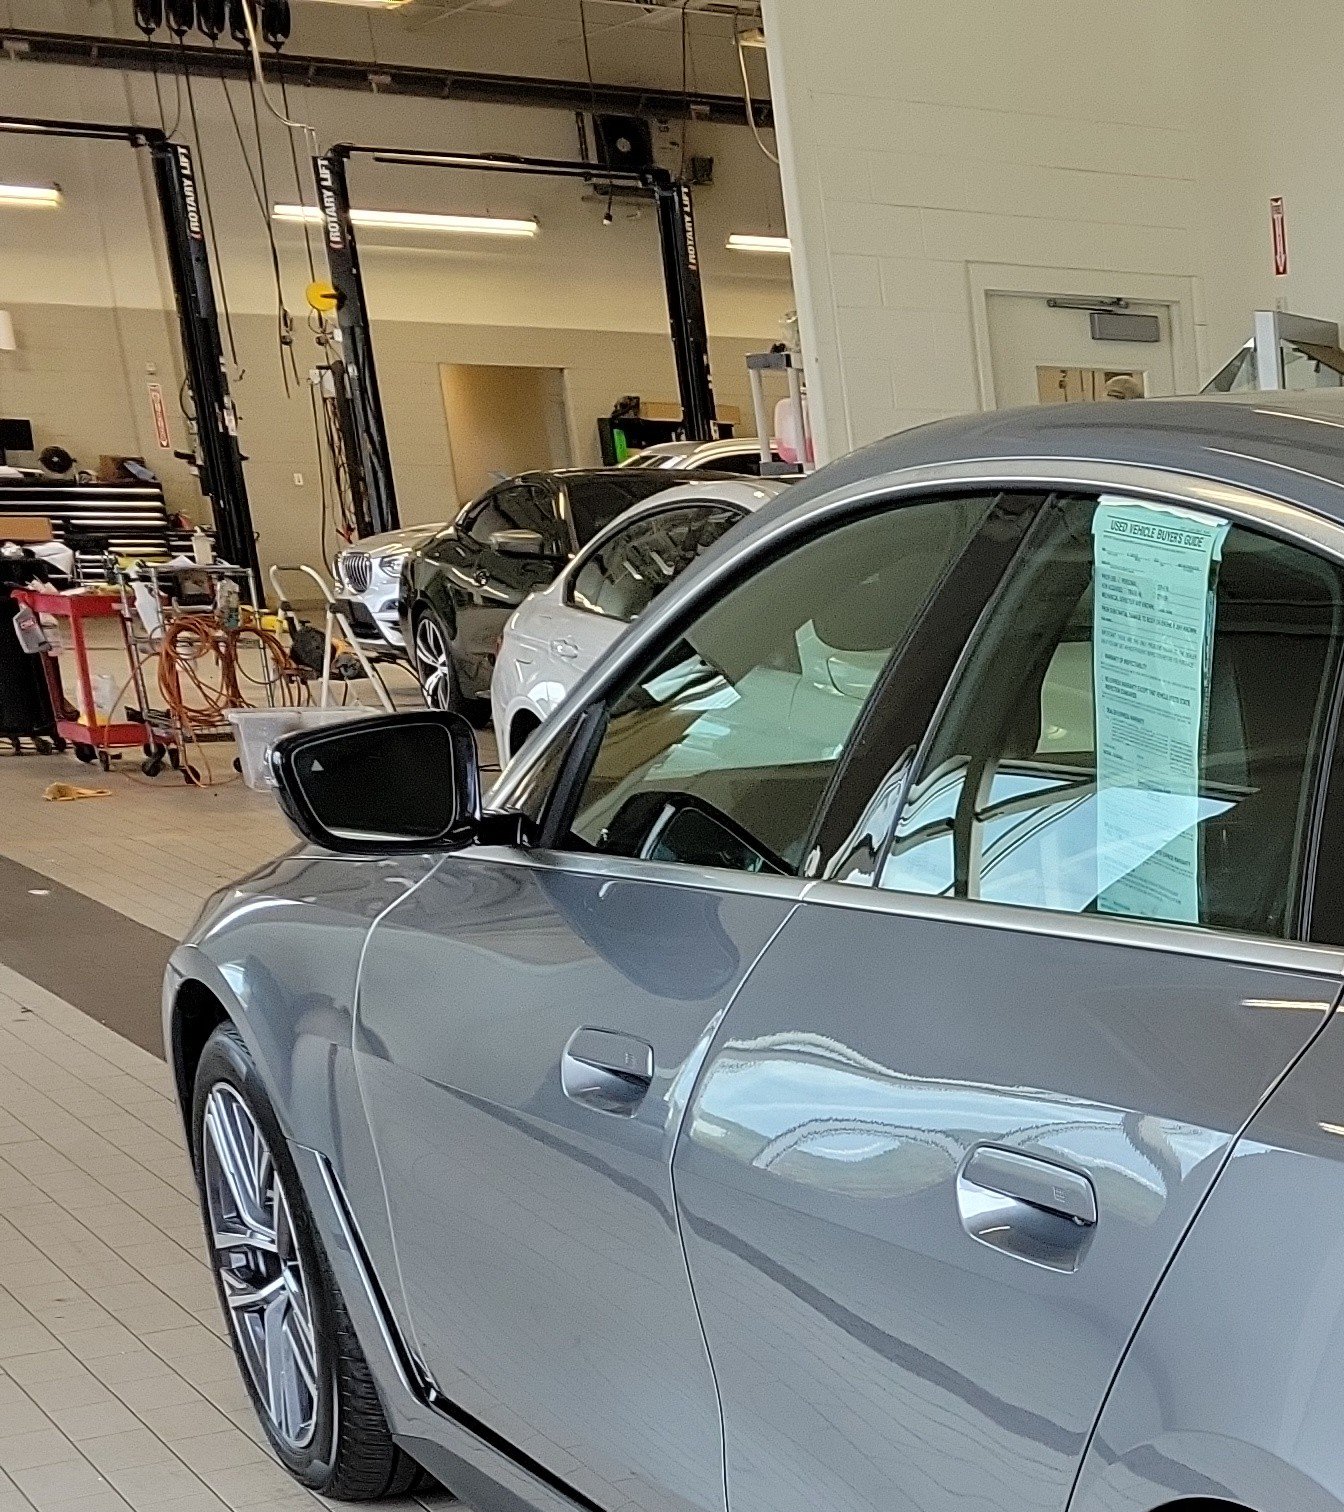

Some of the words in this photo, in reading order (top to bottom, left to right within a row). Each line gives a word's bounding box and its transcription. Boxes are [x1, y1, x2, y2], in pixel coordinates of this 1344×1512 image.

[177, 145, 192, 175] LIFT
[317, 157, 333, 187] LIFT
[182, 177, 201, 232] ROTARY
[321, 188, 342, 242] ROTARY
[684, 213, 697, 264] ROTARY
[1109, 519, 1128, 533] USED
[1129, 523, 1156, 539] VEHICLE
[1184, 534, 1205, 548] GUIDE
